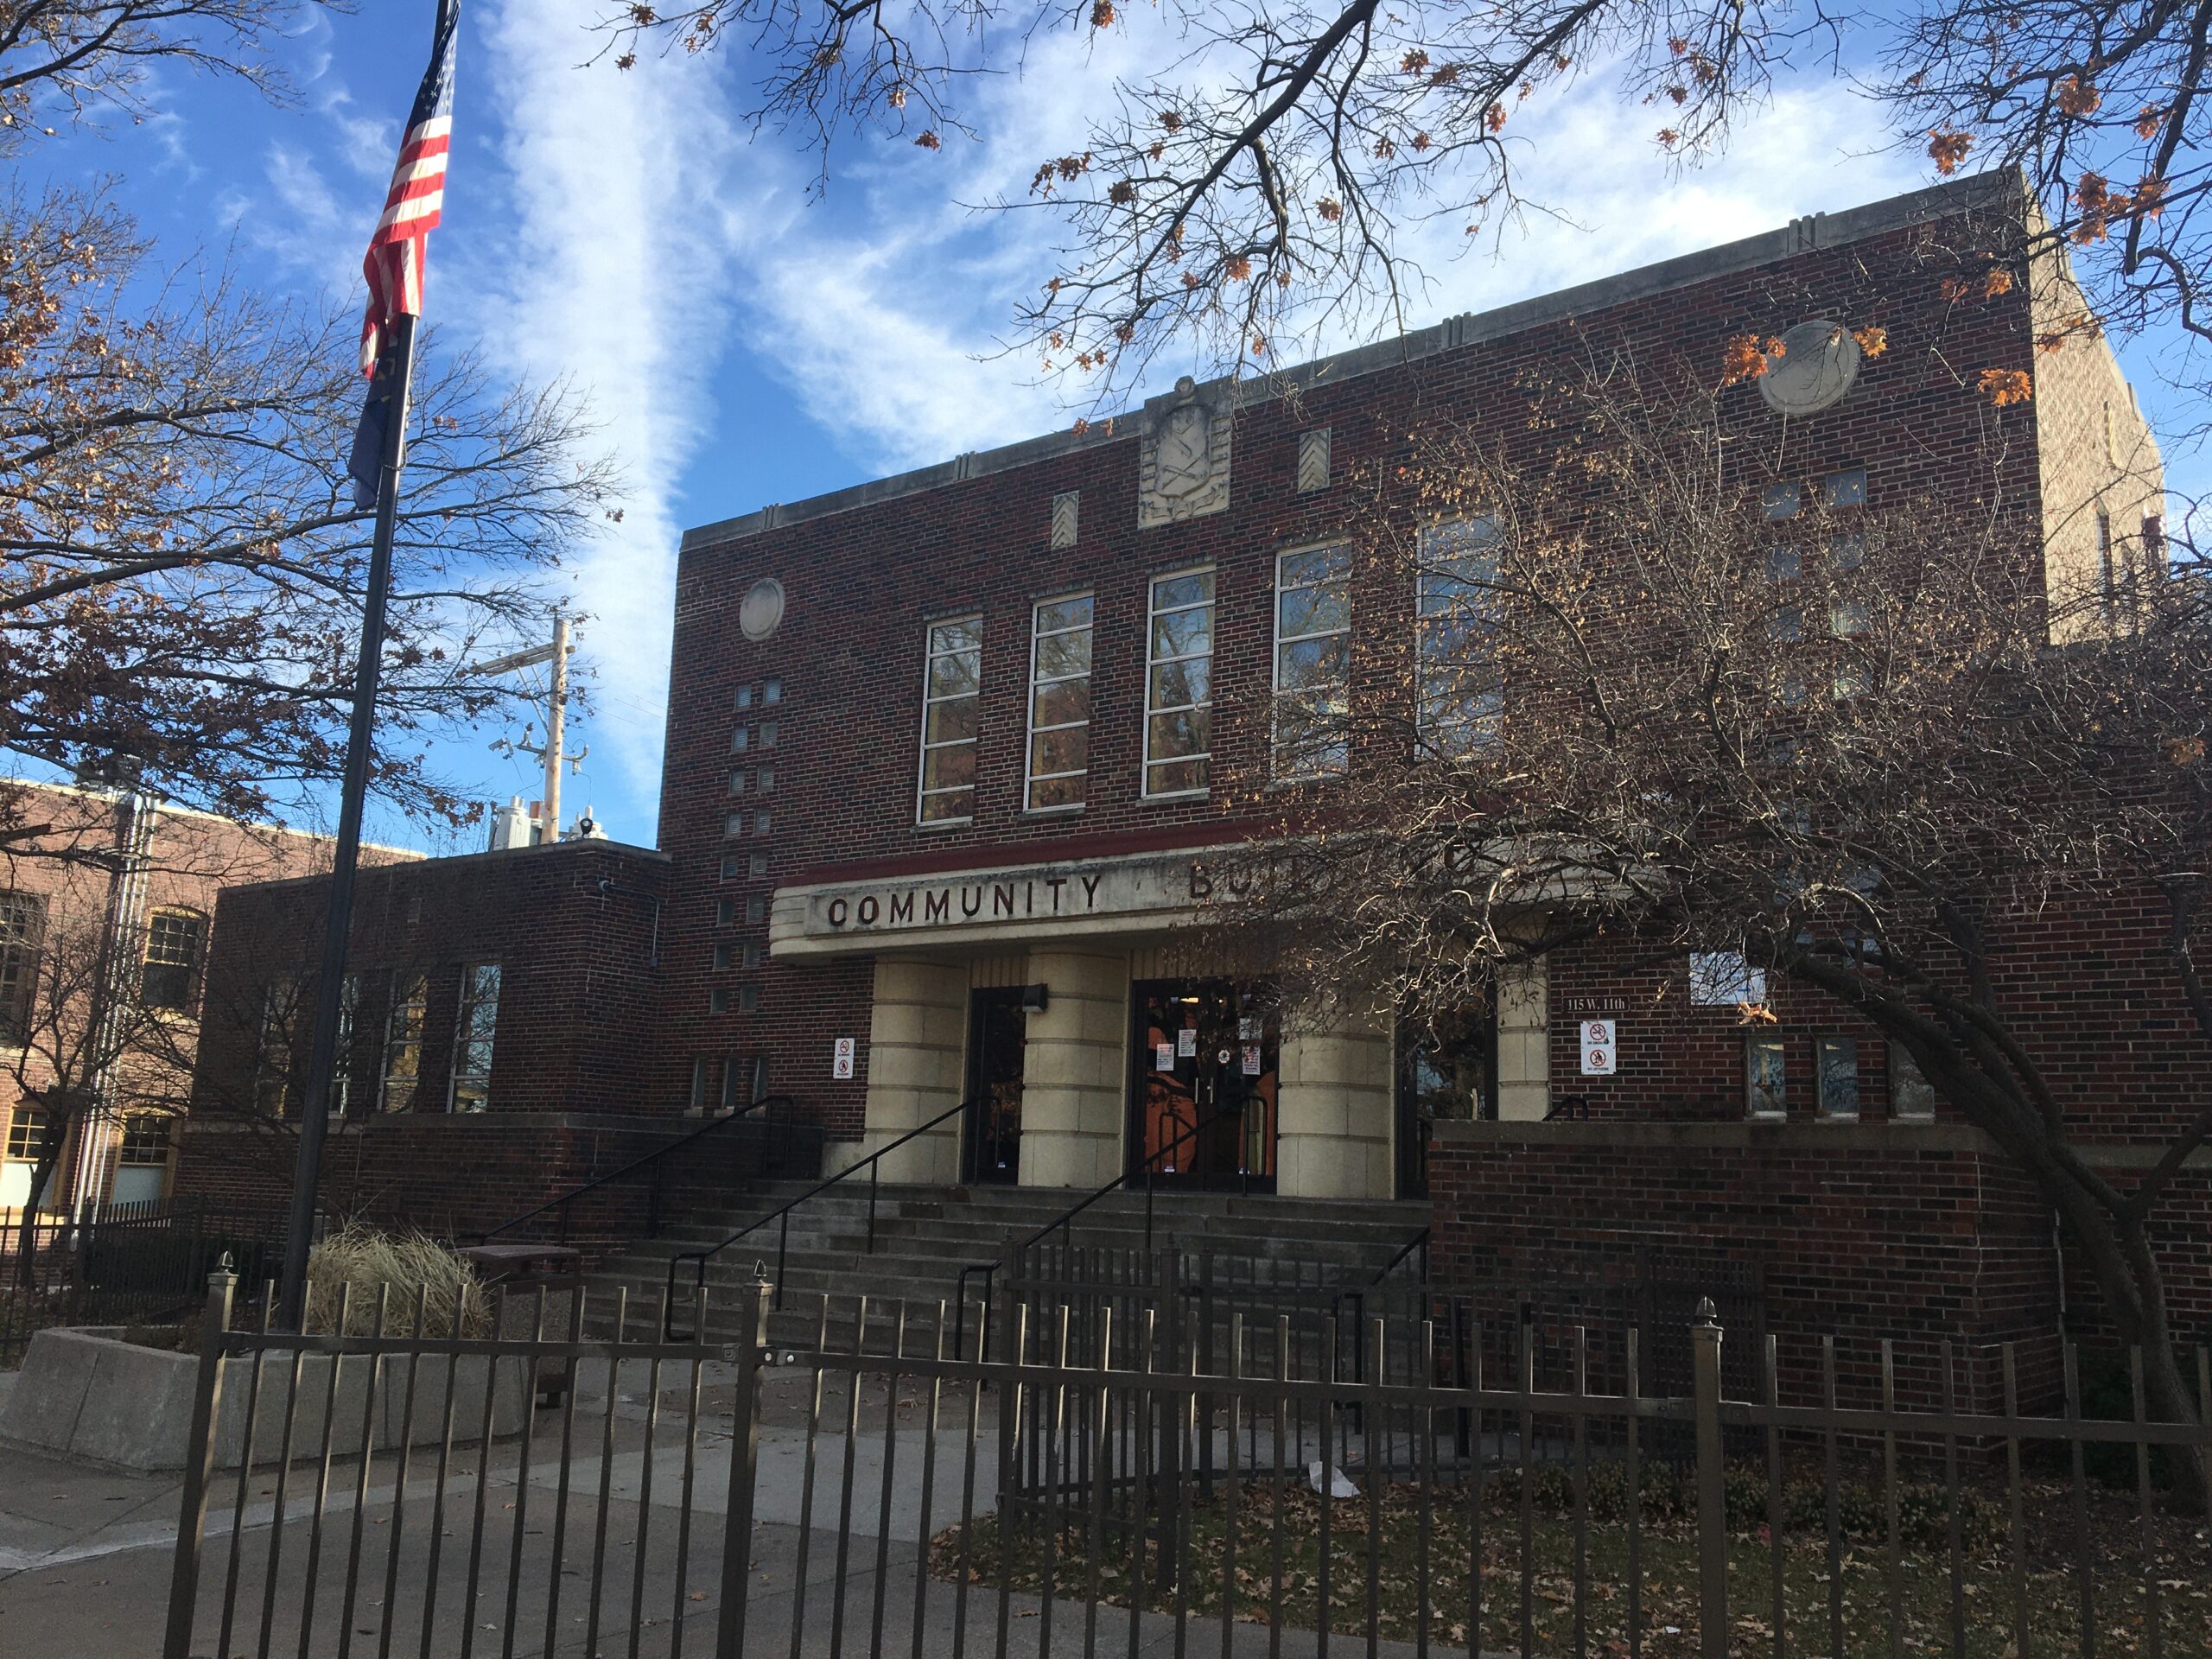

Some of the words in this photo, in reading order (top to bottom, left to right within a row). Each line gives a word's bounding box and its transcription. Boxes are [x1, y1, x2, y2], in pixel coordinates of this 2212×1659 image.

[828, 875, 1102, 927] COMMUNITY
[1567, 999, 1585, 1011] 115
[1586, 998, 1600, 1010] W.
[1604, 997, 1625, 1010] 11th
